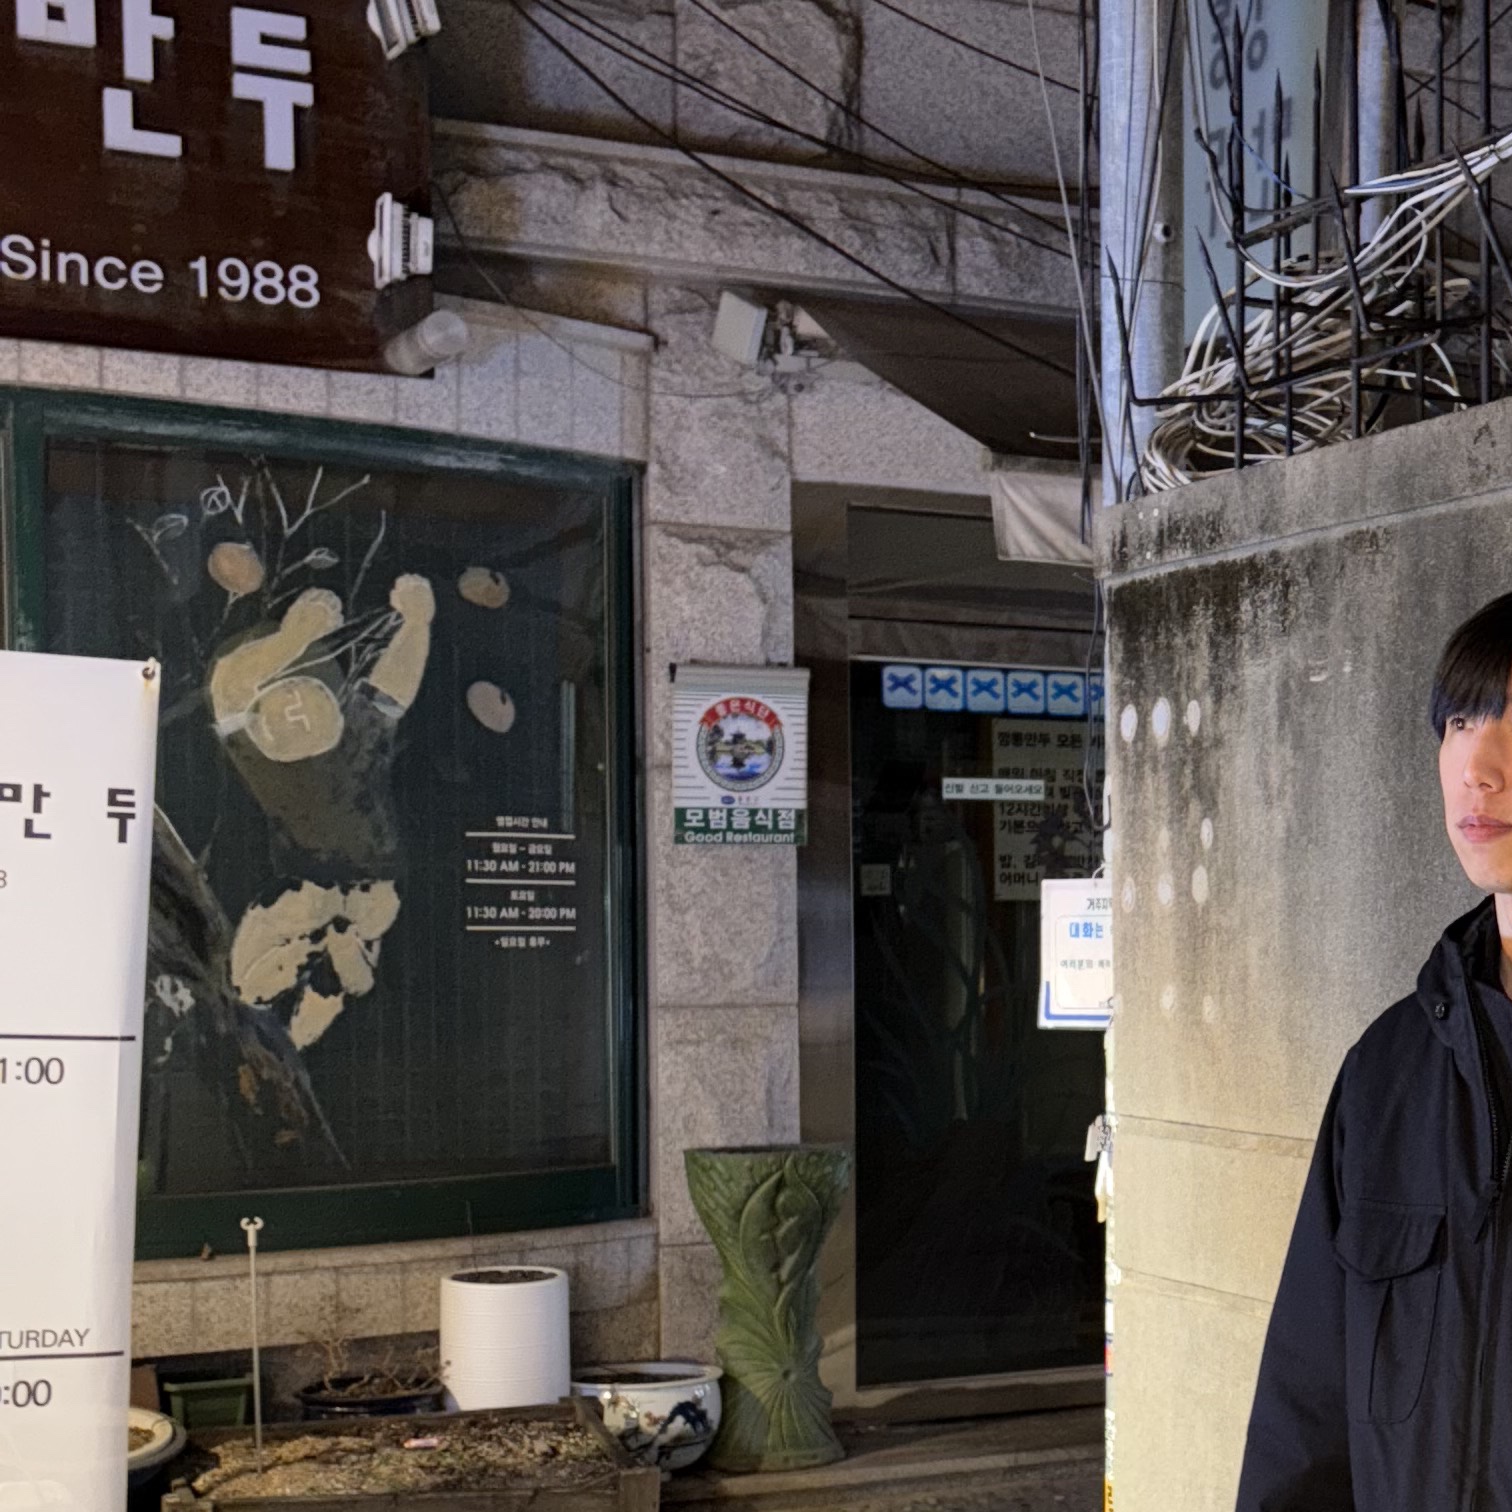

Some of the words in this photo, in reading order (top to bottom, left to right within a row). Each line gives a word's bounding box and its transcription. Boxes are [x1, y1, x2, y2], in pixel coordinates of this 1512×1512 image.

[0, 234, 164, 293] Since
[189, 256, 321, 309] 1988
[684, 808, 796, 830] 모범음식점
[684, 831, 722, 844] Good
[726, 831, 795, 844] Restaurant
[466, 859, 497, 873] 11:30
[500, 861, 519, 873] AM
[528, 861, 557, 874] 21:00
[559, 862, 576, 874] PM
[466, 906, 497, 919] 11:30
[500, 907, 519, 919] AM
[528, 906, 557, 920] 20:00
[559, 908, 576, 920] PM
